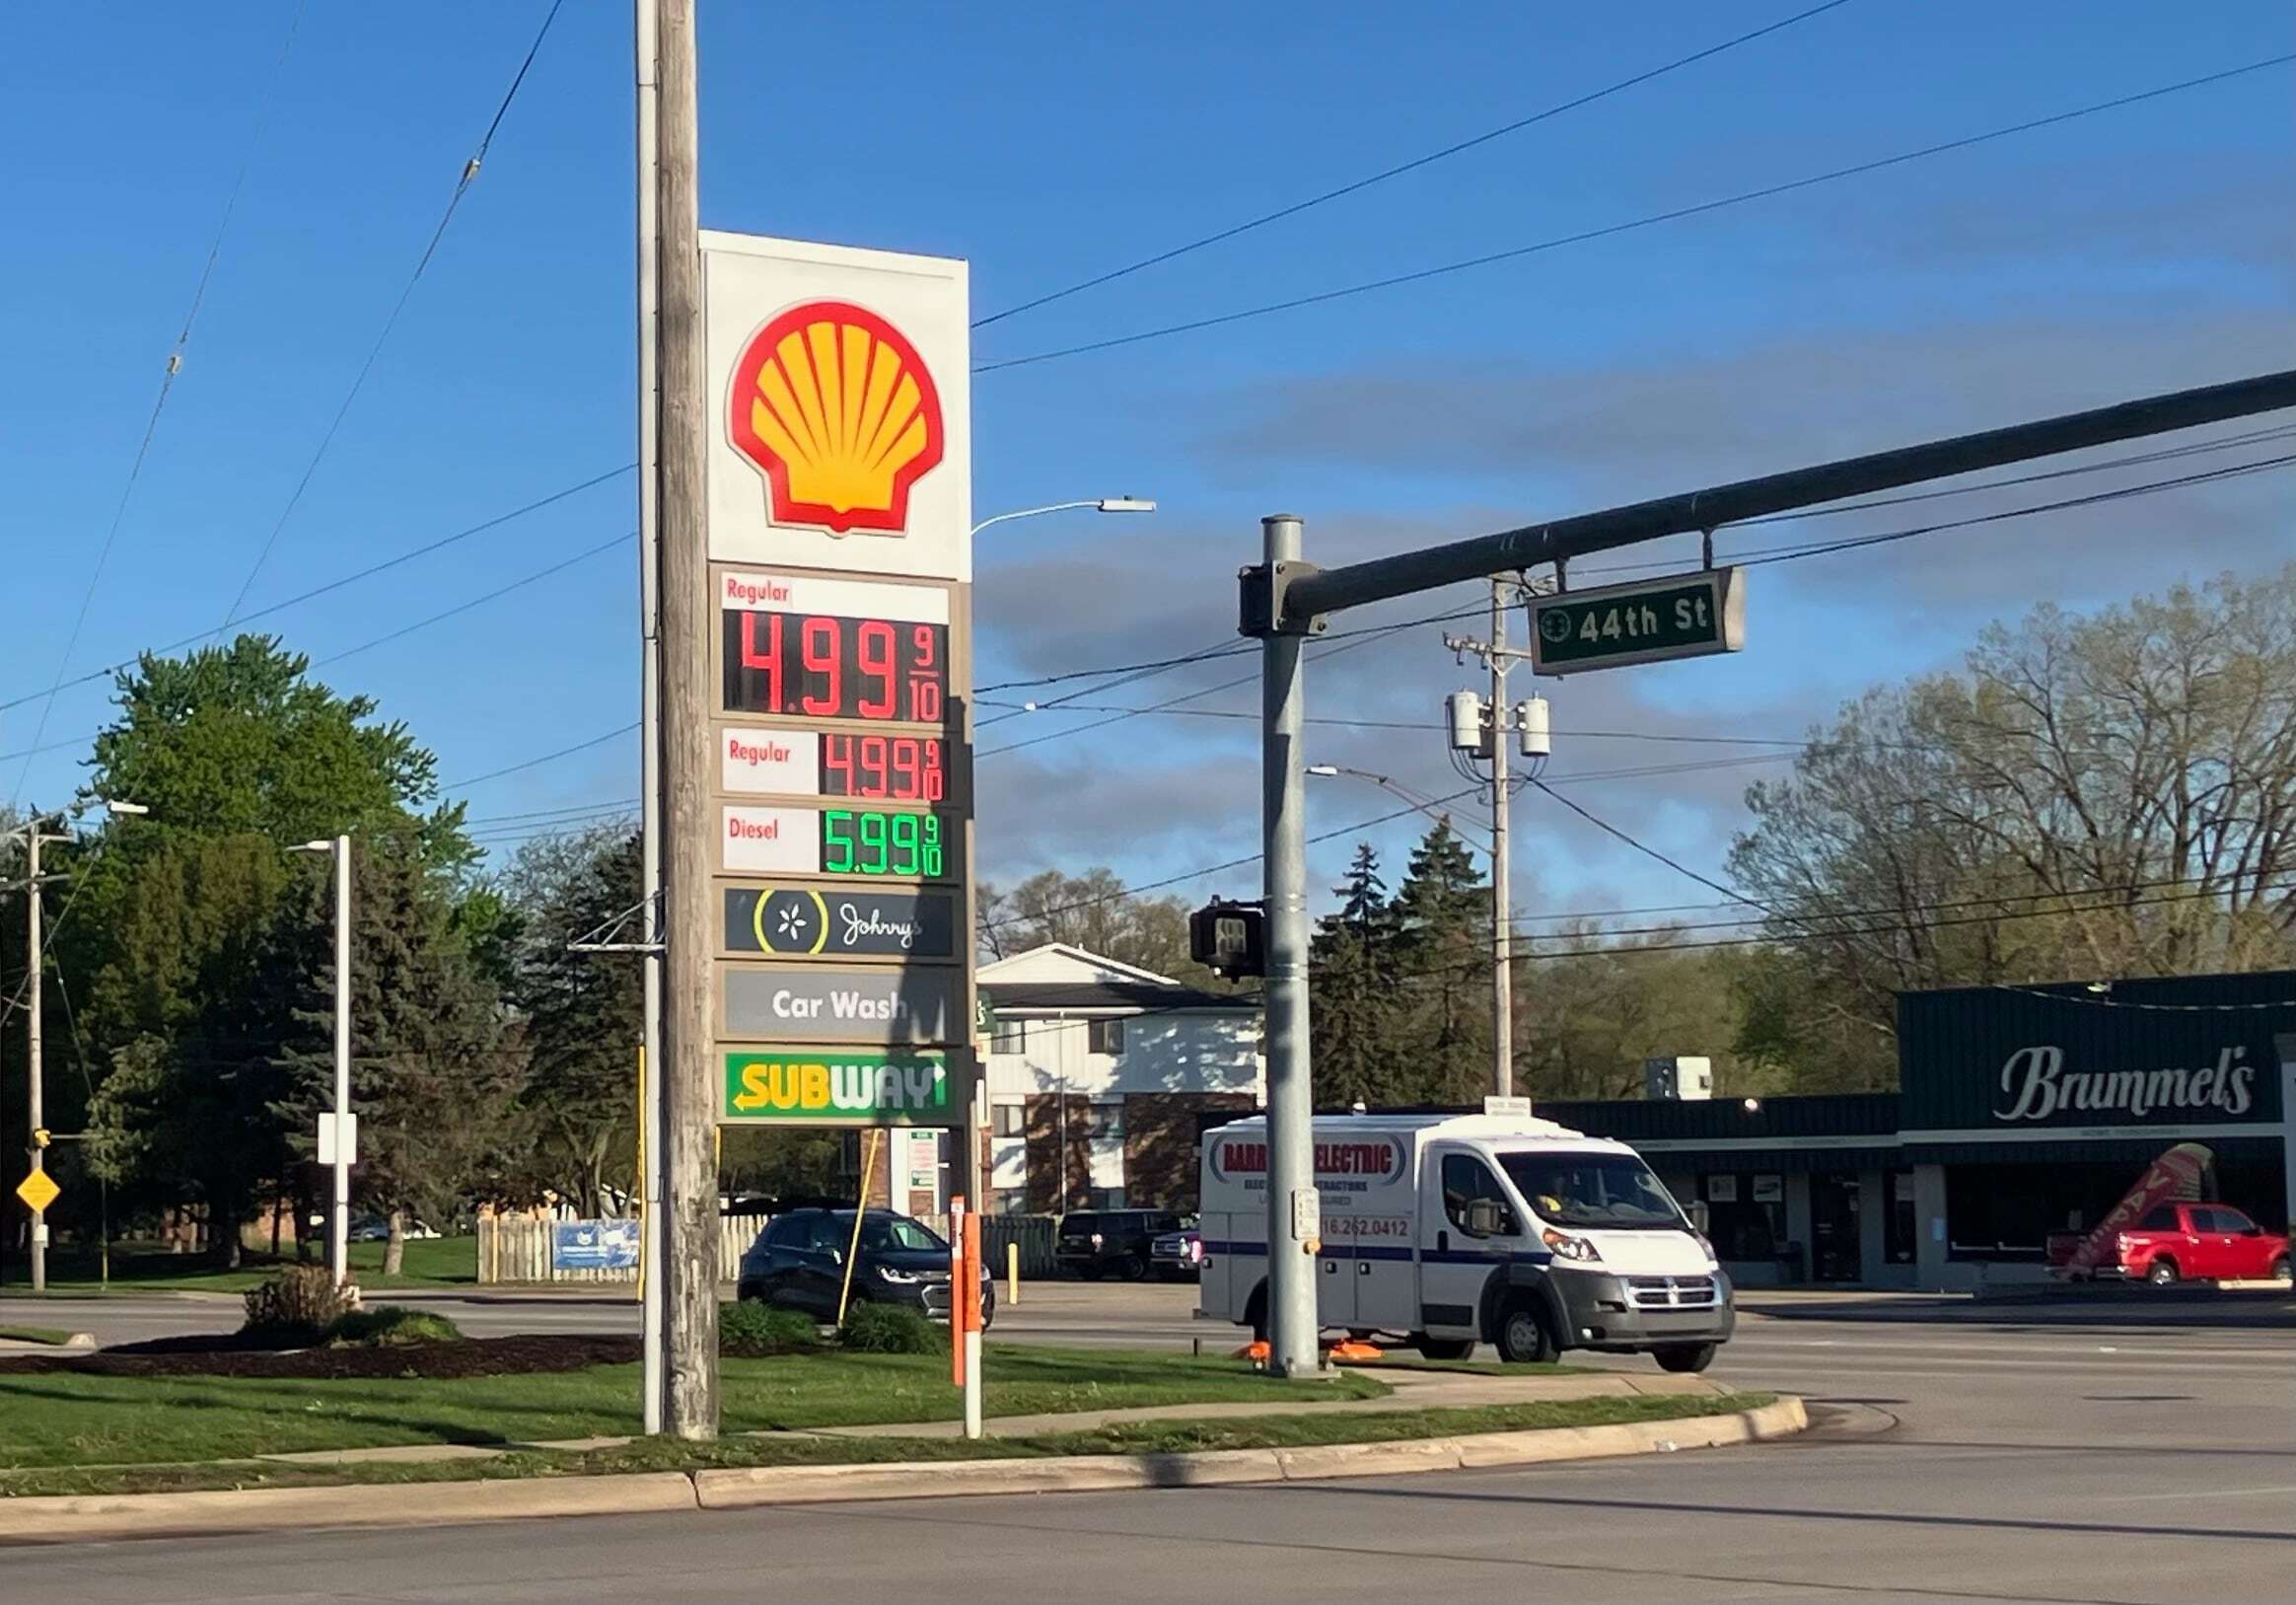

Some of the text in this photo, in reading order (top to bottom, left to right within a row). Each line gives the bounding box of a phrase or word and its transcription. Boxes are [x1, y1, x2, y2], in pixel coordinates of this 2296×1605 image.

[727, 578, 789, 604] Regular
[1579, 595, 1708, 642] 44th St
[729, 740, 790, 766] Regular
[729, 818, 778, 839] Diesel
[772, 989, 907, 1019] Car Wash
[733, 1063, 946, 1110] SUBWAY
[1992, 1045, 2256, 1121] Brummel's
[1314, 1144, 1392, 1174] ELECTRIC
[1323, 1217, 1407, 1237] 16.262.0412
